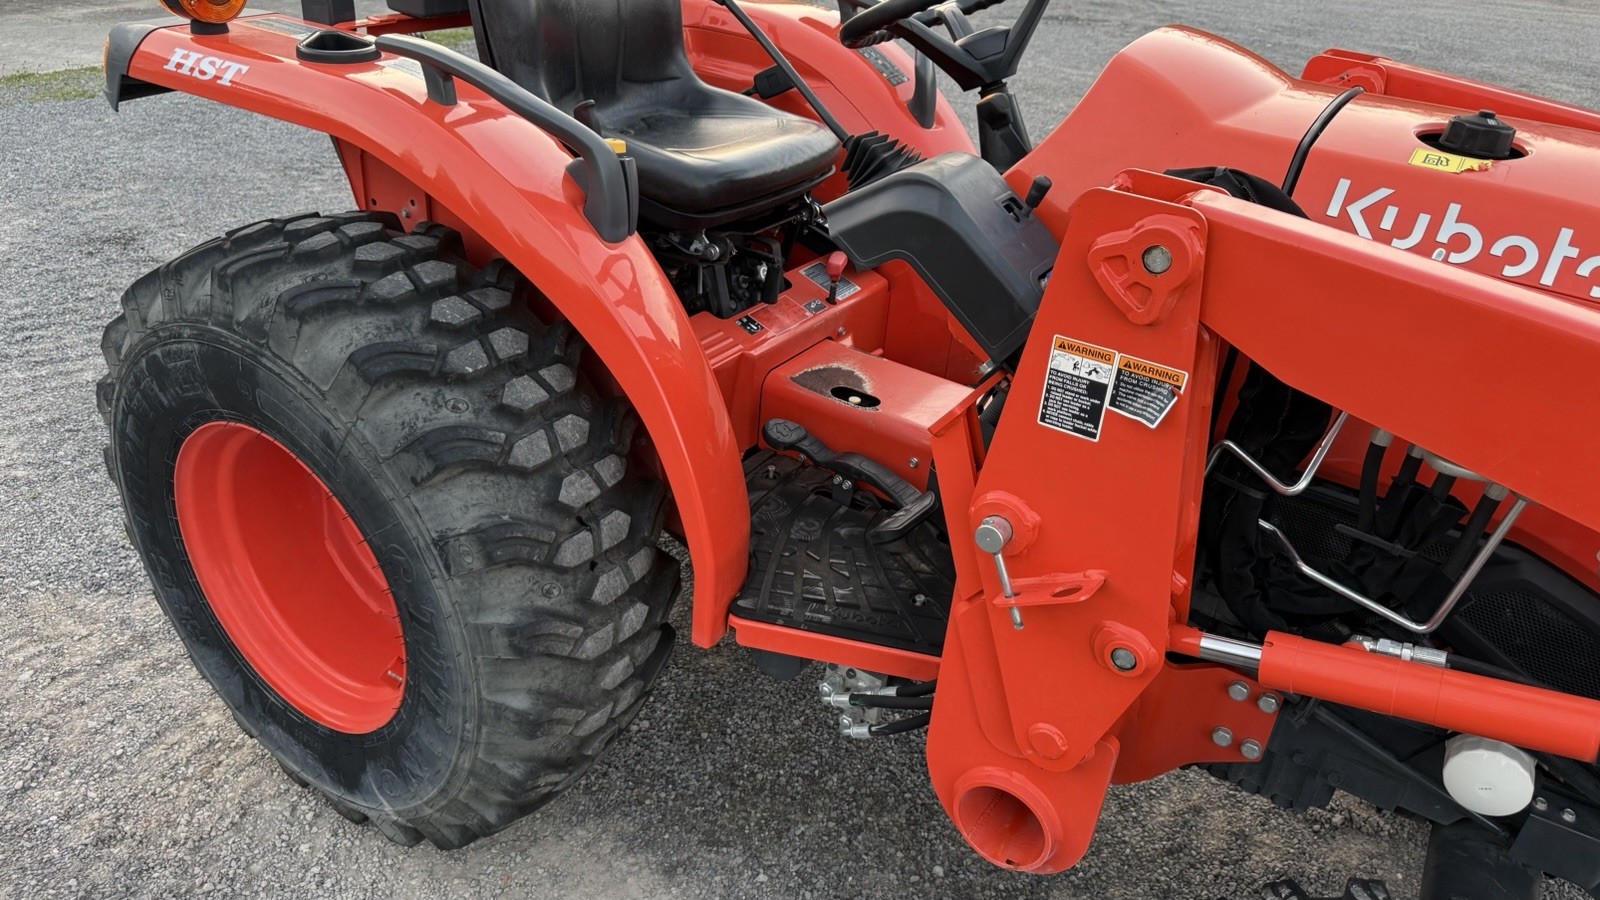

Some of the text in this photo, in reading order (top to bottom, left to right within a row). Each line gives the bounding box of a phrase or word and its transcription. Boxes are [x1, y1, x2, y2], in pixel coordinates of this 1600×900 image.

[163, 47, 250, 87] HST
[1066, 343, 1112, 362] WARNING
[1120, 376, 1138, 384] FROM
[1131, 373, 1150, 382] AVOID
[1132, 362, 1180, 382] WARNING
